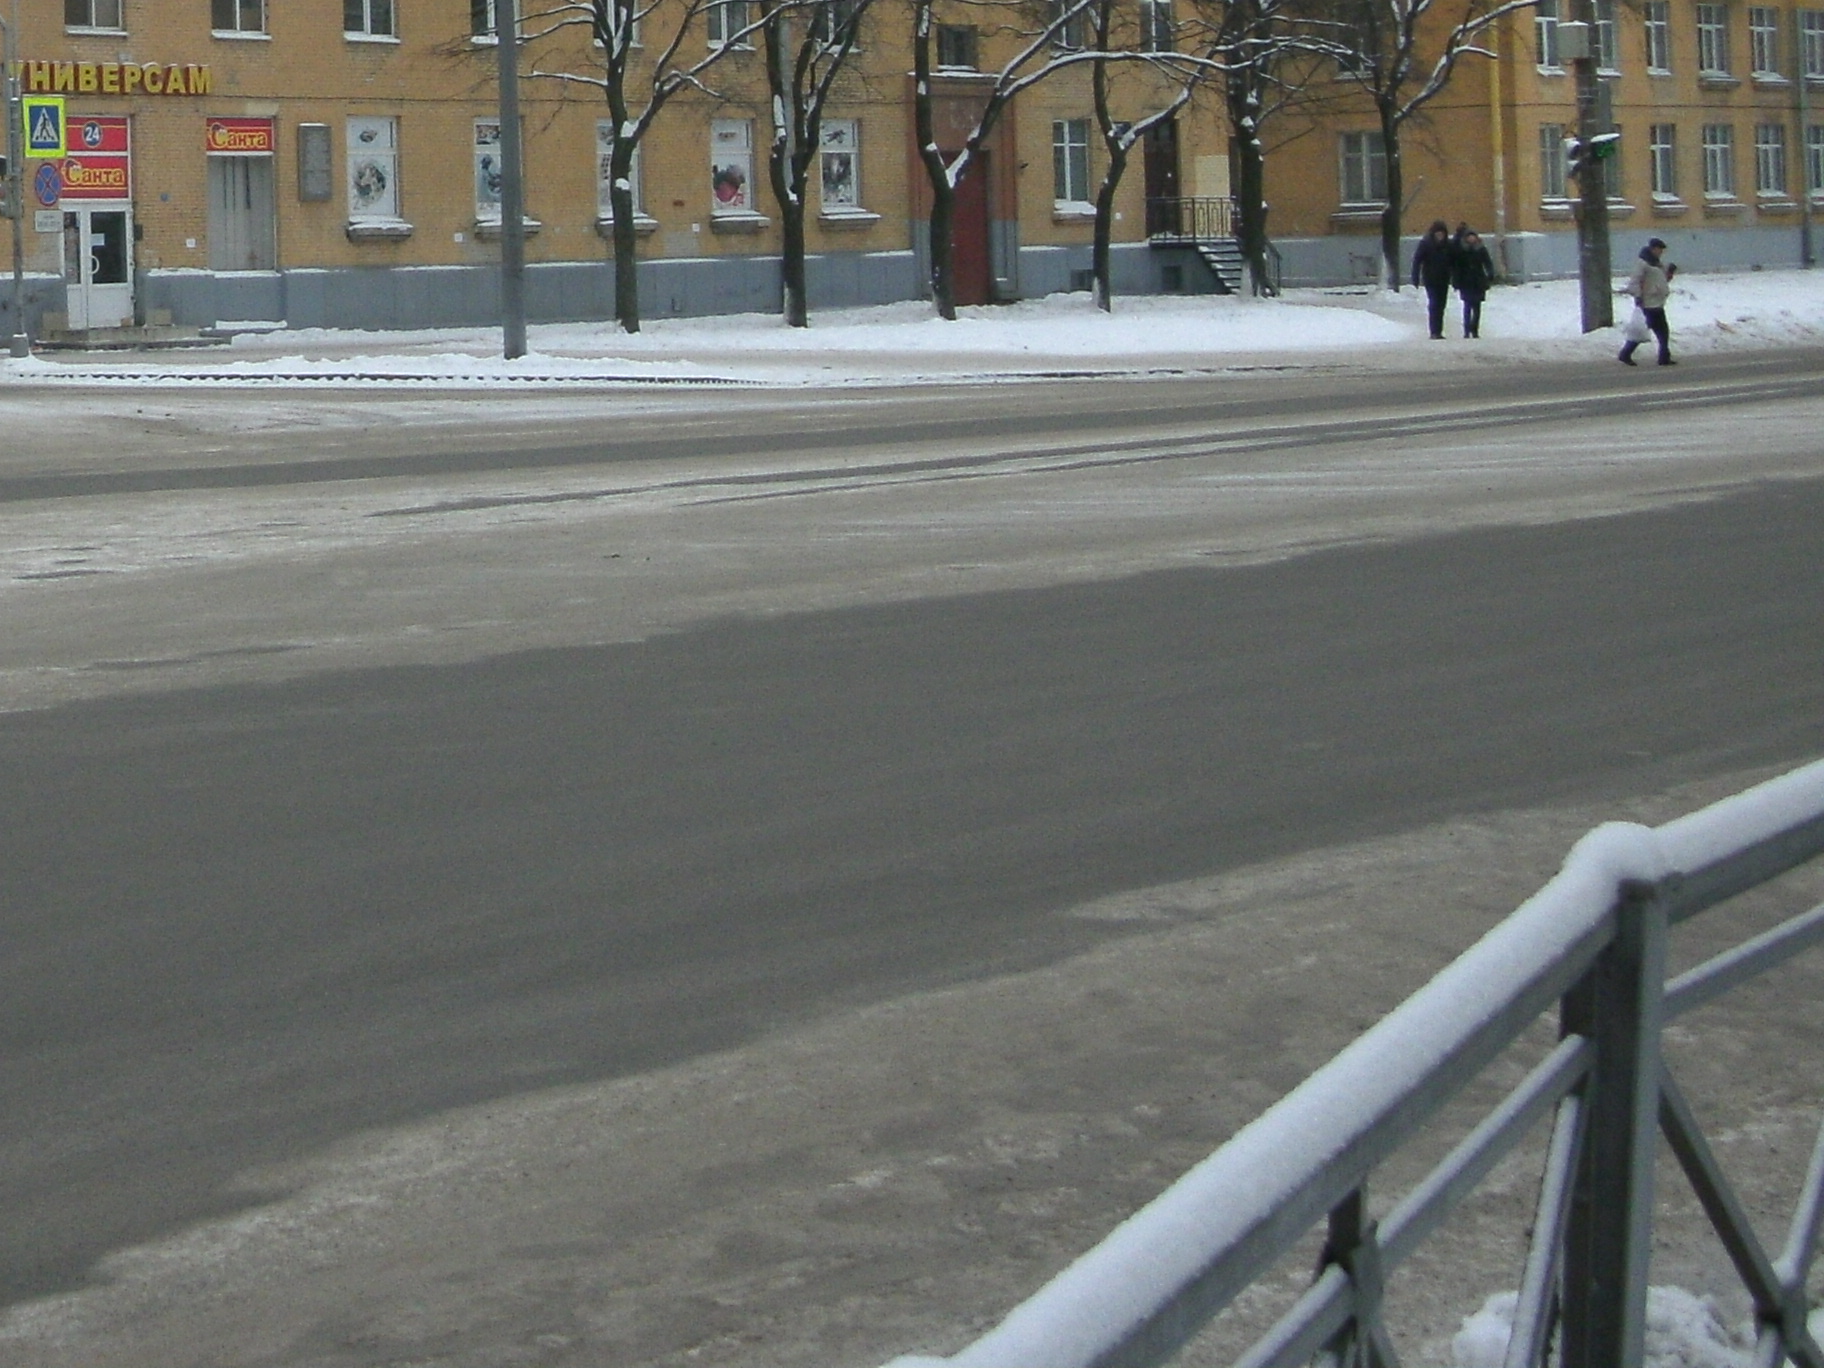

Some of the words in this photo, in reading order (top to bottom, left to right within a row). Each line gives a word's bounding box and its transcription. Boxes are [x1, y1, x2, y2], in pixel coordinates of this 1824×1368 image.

[83, 126, 99, 141] 24
[210, 123, 268, 148] Санта
[63, 160, 126, 186] Санта
